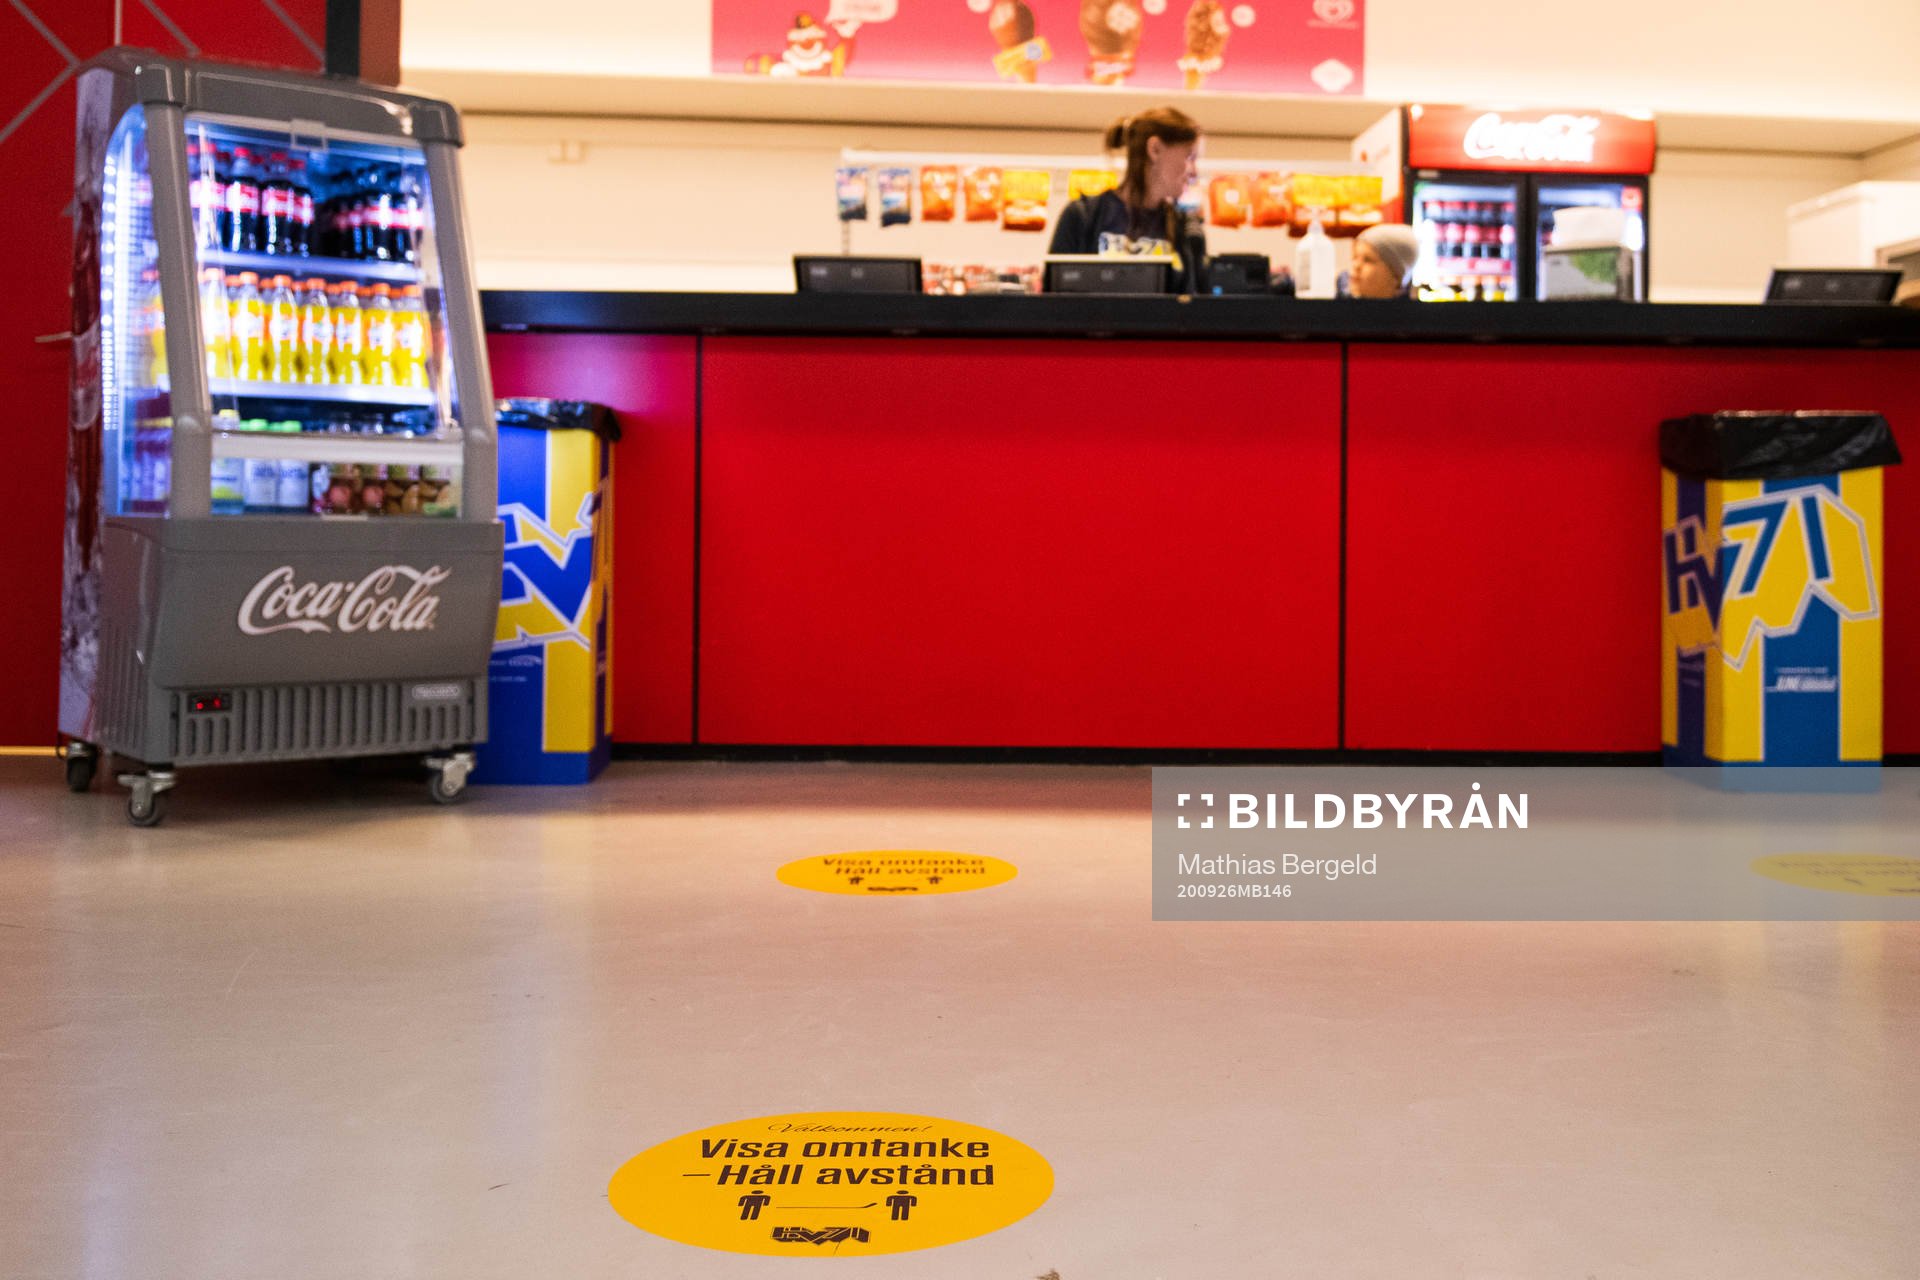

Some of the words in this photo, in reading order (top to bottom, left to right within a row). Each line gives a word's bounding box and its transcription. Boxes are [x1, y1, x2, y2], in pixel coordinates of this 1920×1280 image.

[237, 565, 452, 635] Coca-Cola
[701, 1139, 789, 1158] Visa
[802, 1138, 989, 1158] omtanke
[816, 1164, 994, 1185] avstånd
